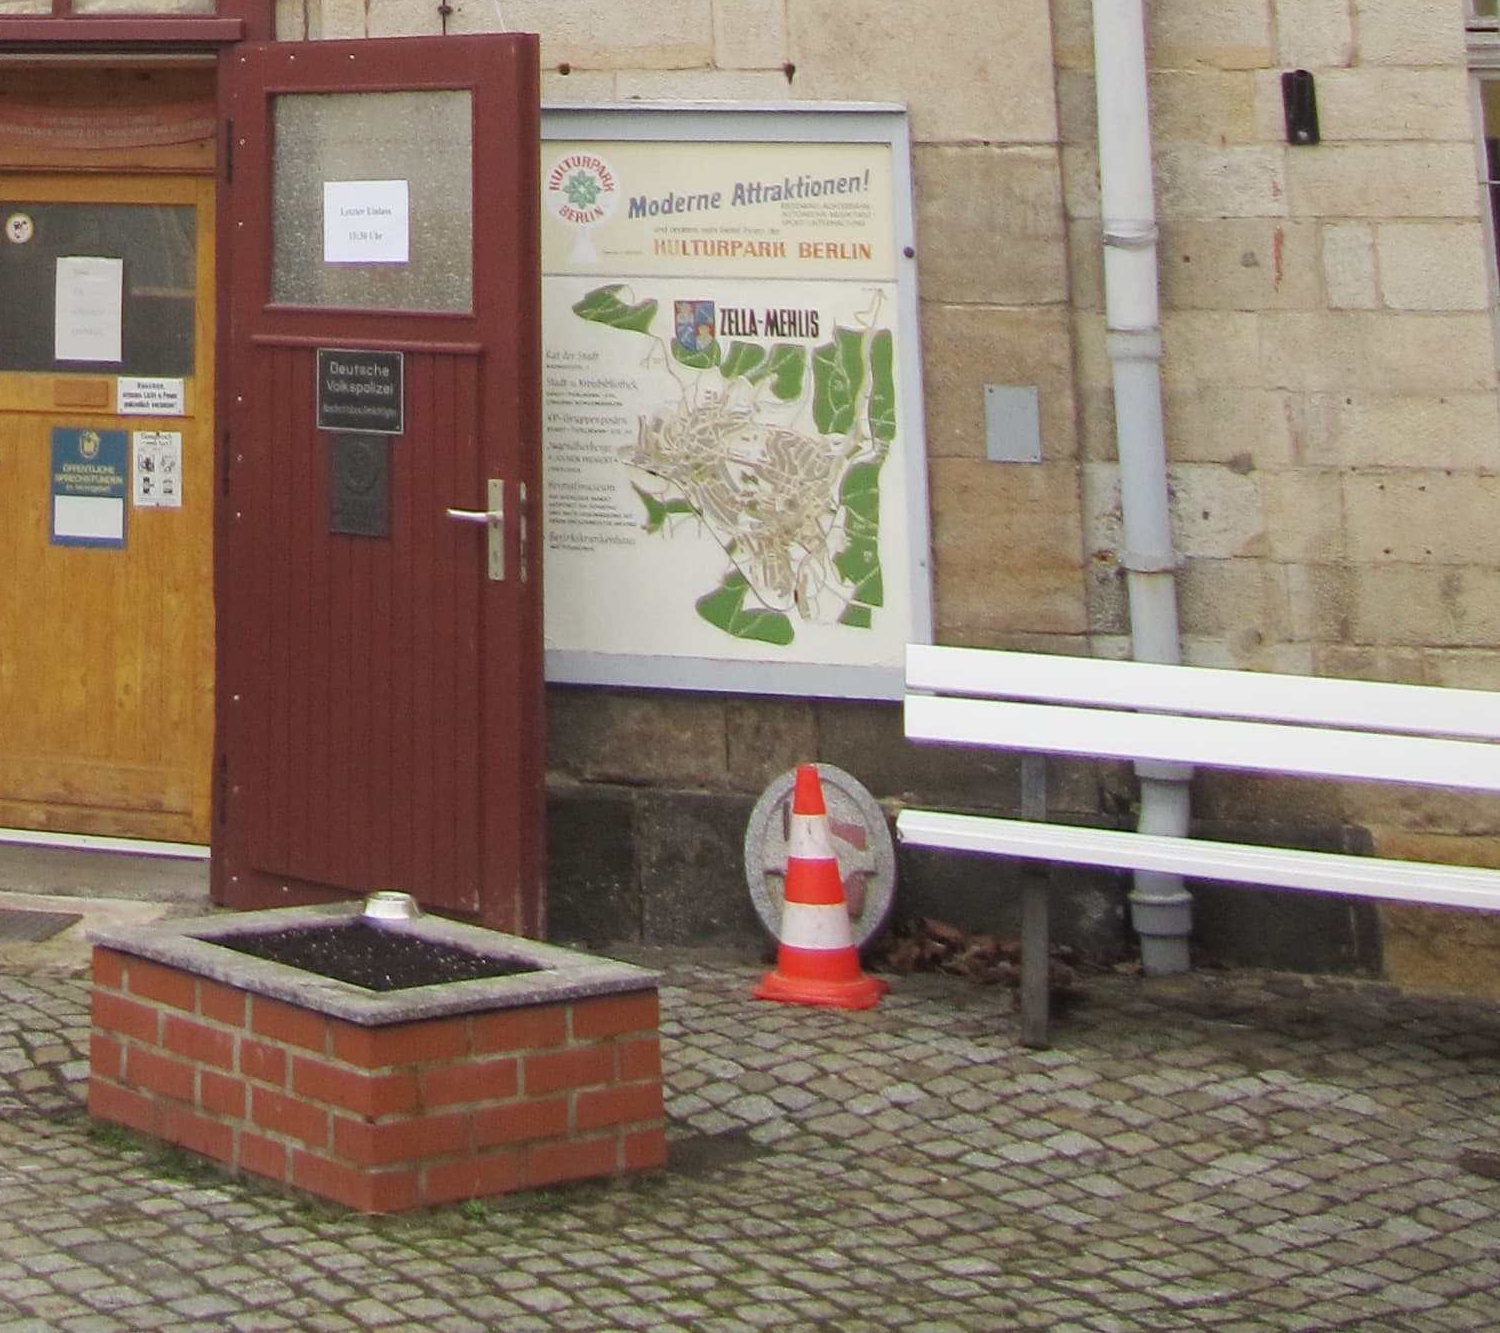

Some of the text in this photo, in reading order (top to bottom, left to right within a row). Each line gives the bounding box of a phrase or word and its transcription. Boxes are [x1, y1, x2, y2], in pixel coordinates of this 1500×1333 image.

[628, 168, 870, 220] Moderne Attraktionen!
[558, 205, 605, 224] BERLIN
[798, 241, 872, 260] BERLIN
[719, 307, 820, 339] ZELLA-MEHLIS
[329, 361, 390, 377] Deutsche
[326, 380, 394, 396] Volkspolizei
